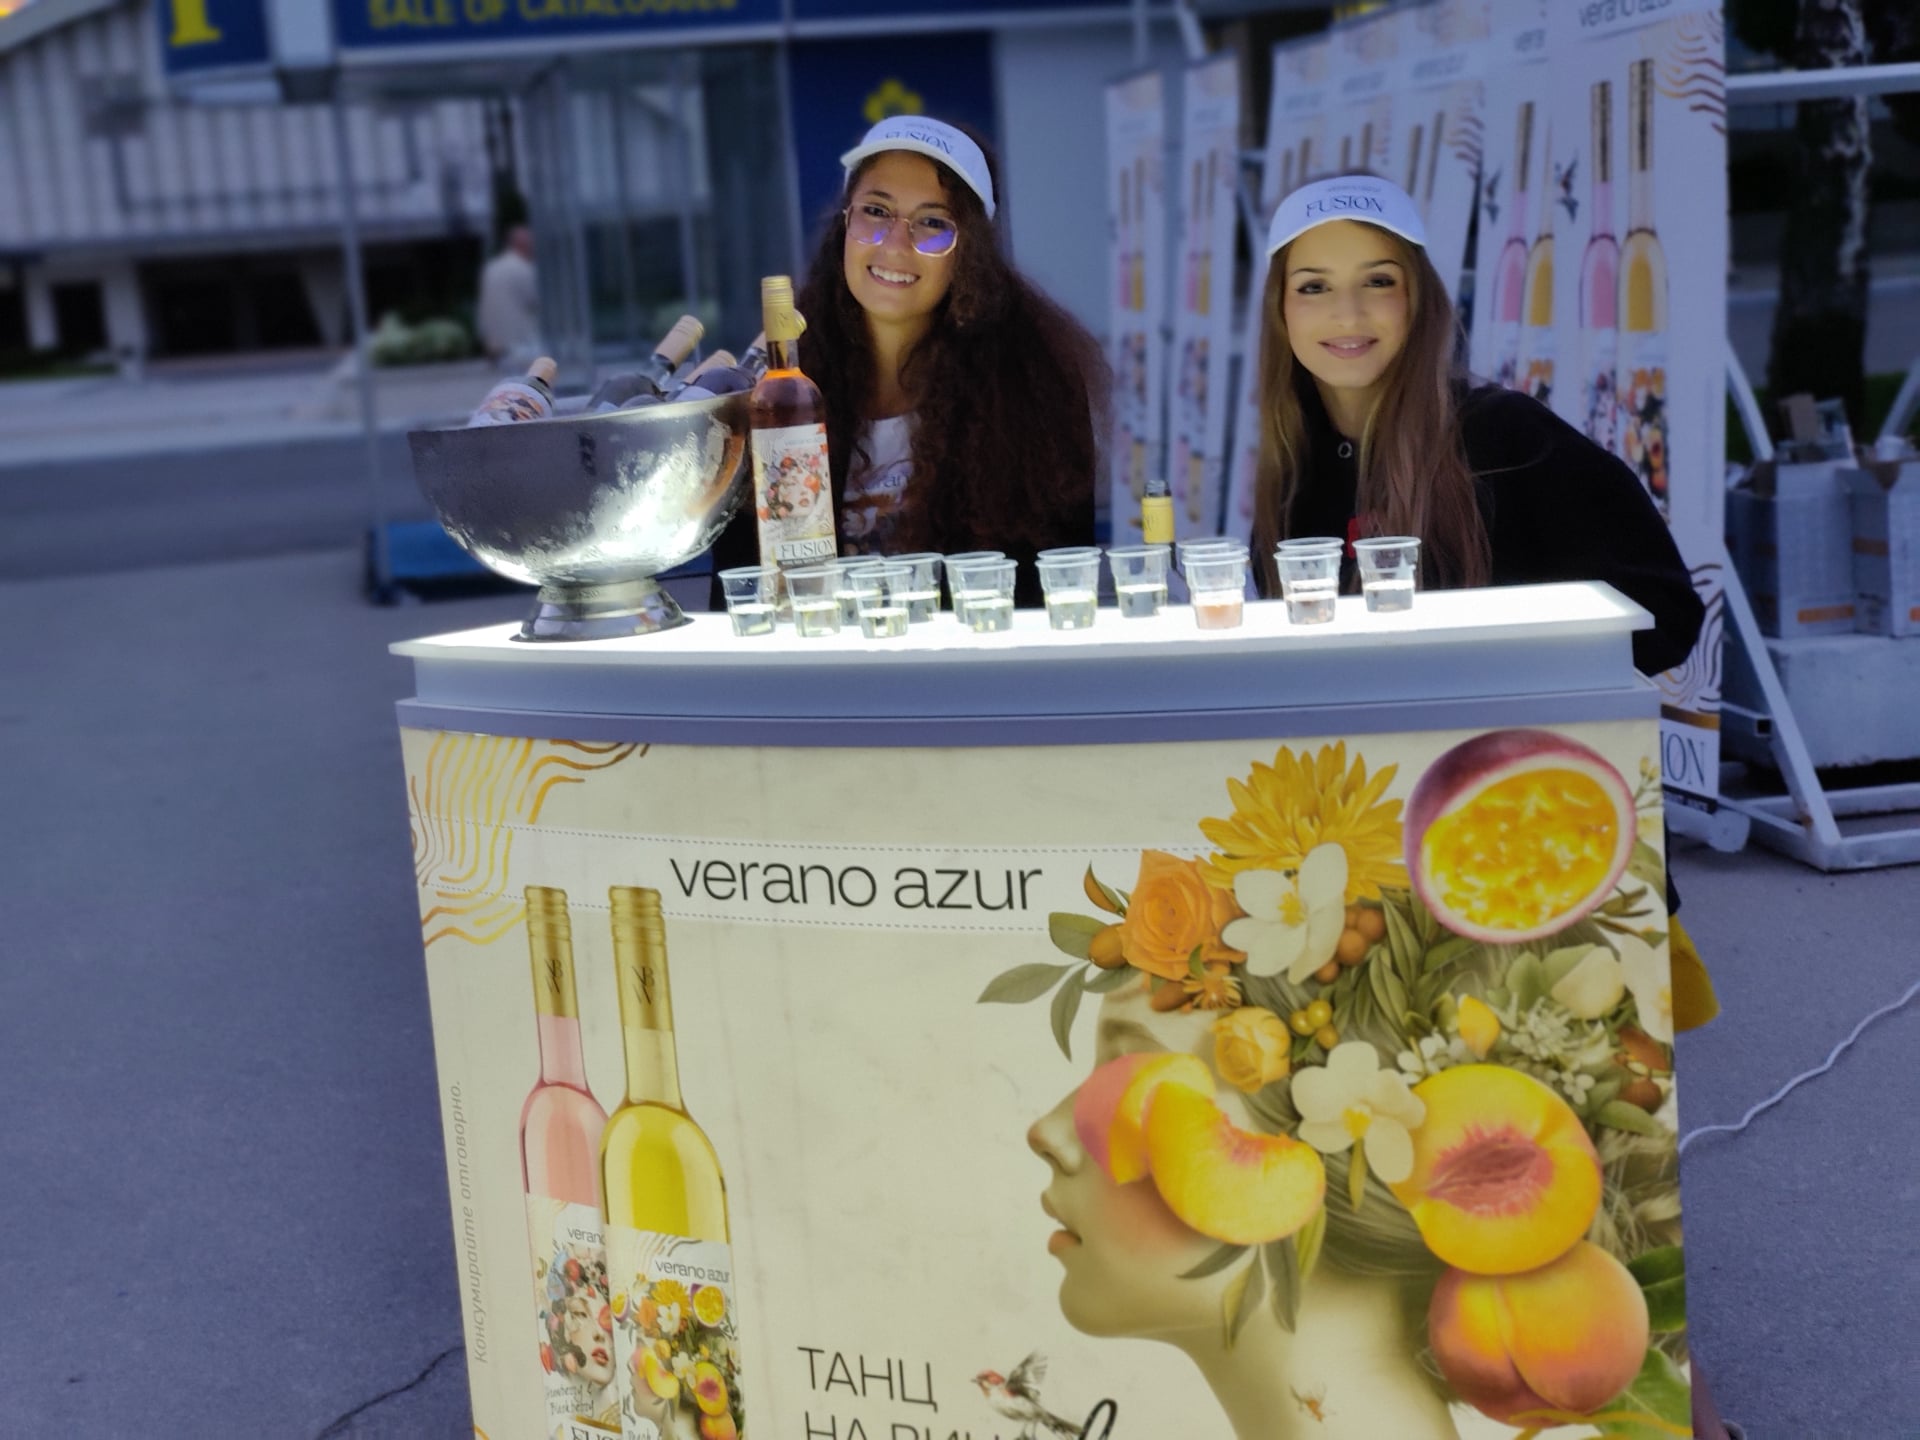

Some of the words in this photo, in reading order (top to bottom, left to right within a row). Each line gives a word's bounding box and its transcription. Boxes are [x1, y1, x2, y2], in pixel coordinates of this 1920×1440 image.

[1306, 195, 1383, 217] FUSION
[780, 539, 834, 559] FUSION
[669, 858, 878, 907] verano
[893, 866, 1043, 911] azur
[450, 1080, 473, 1200] отговорно.
[463, 1205, 488, 1364] Консумирайте
[655, 1259, 706, 1280] verano
[707, 1268, 730, 1283] azur
[797, 1346, 938, 1413] ТАНЦ
[804, 1410, 869, 1440] НА
